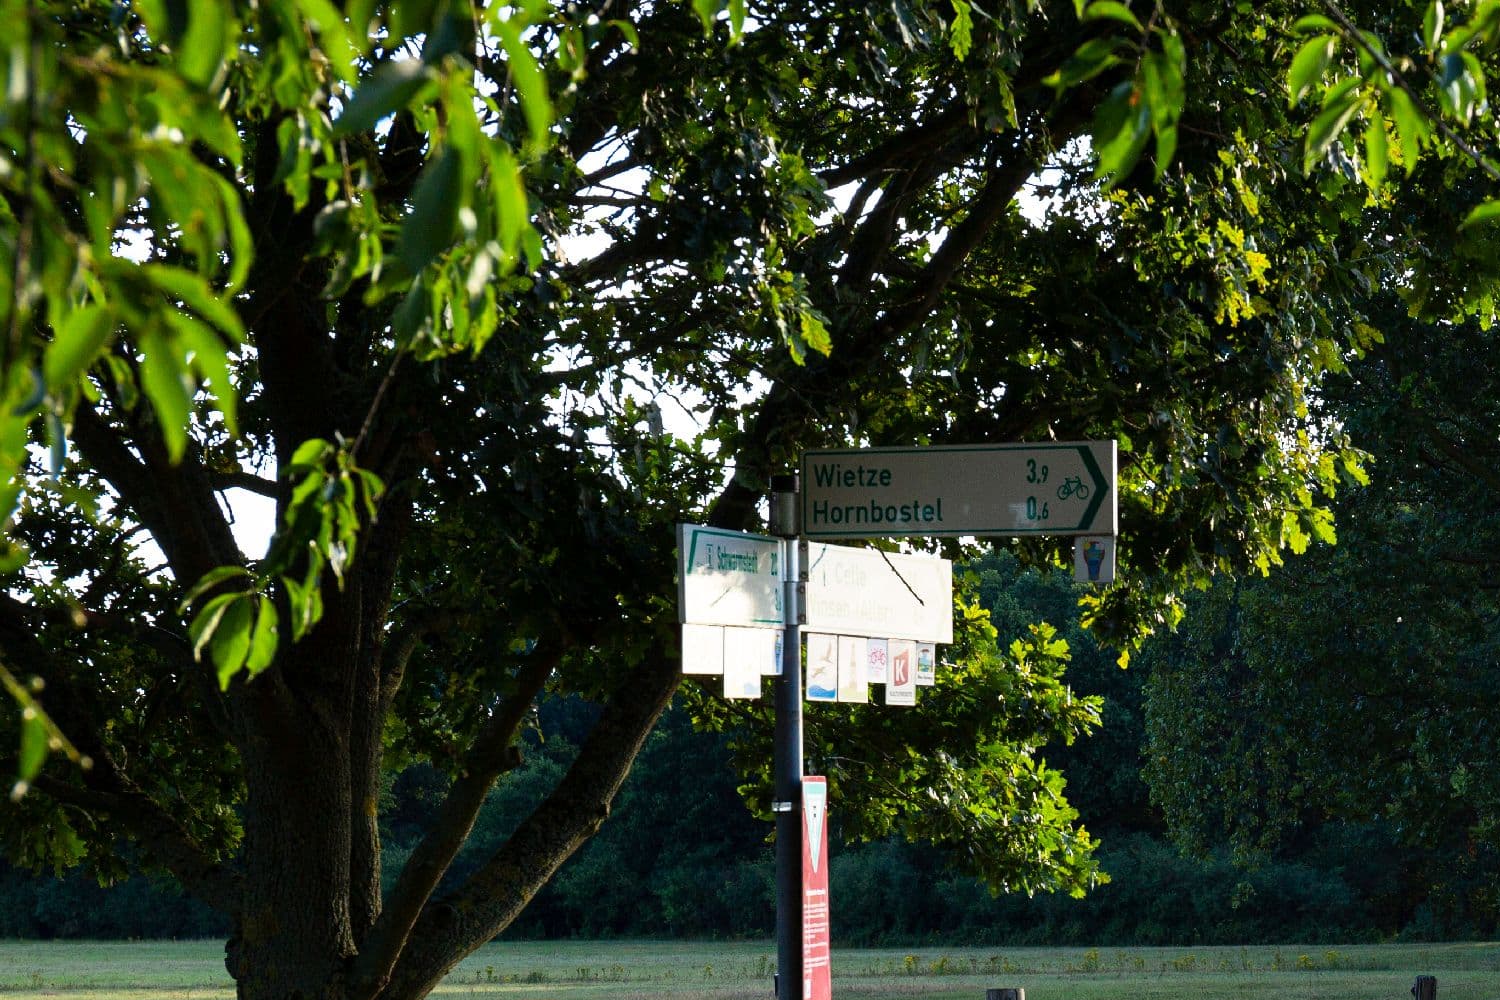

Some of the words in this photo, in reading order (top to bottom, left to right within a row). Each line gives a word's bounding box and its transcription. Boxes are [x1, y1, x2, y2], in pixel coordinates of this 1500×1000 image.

[813, 463, 892, 488] Wietze
[1026, 458, 1049, 484] 3,9
[813, 497, 943, 524] Hornbostel
[1026, 495, 1049, 520] 0,6
[895, 659, 906, 682] K
